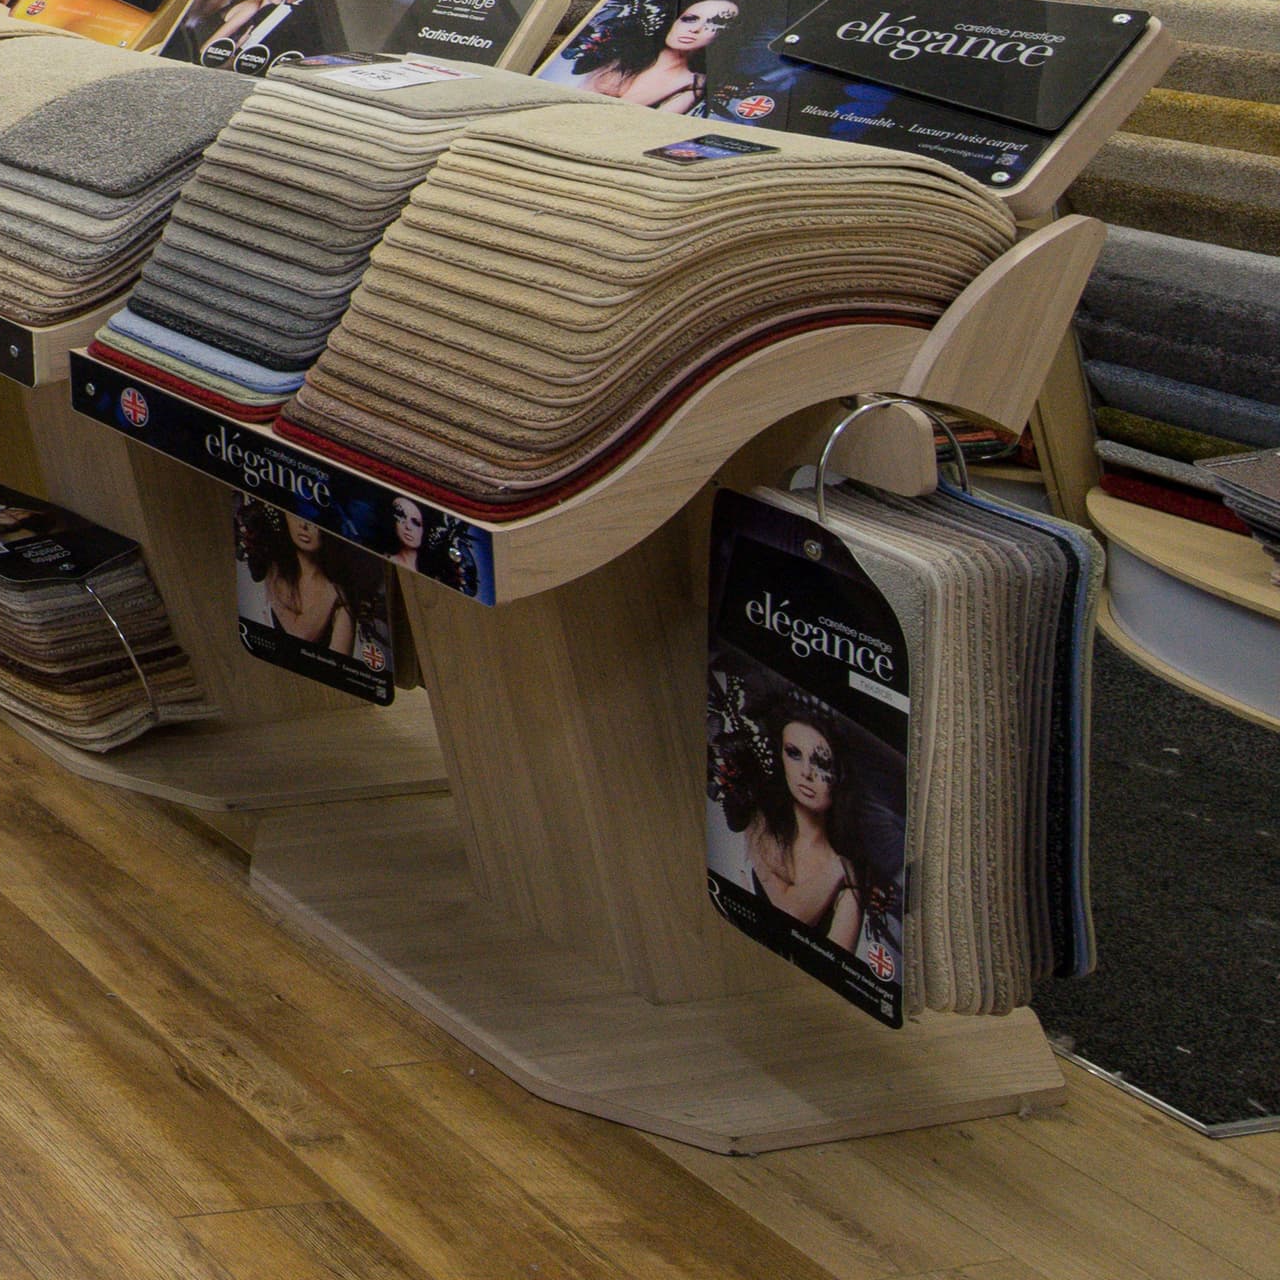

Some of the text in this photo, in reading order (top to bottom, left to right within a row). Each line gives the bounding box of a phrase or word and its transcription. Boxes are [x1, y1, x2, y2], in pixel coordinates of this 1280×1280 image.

[417, 25, 494, 50] Satisfaction
[836, 11, 1055, 67] elégance
[953, 22, 1066, 44] carefree prestige
[239, 54, 267, 65] ACTION
[800, 104, 839, 120] Bleach
[839, 111, 896, 130] cleanable
[908, 122, 956, 141] Luxury
[954, 131, 985, 146] twist
[985, 138, 1029, 153] carpet
[205, 425, 332, 508] elégance
[745, 590, 894, 682] elégance
[817, 615, 858, 638] carefree
